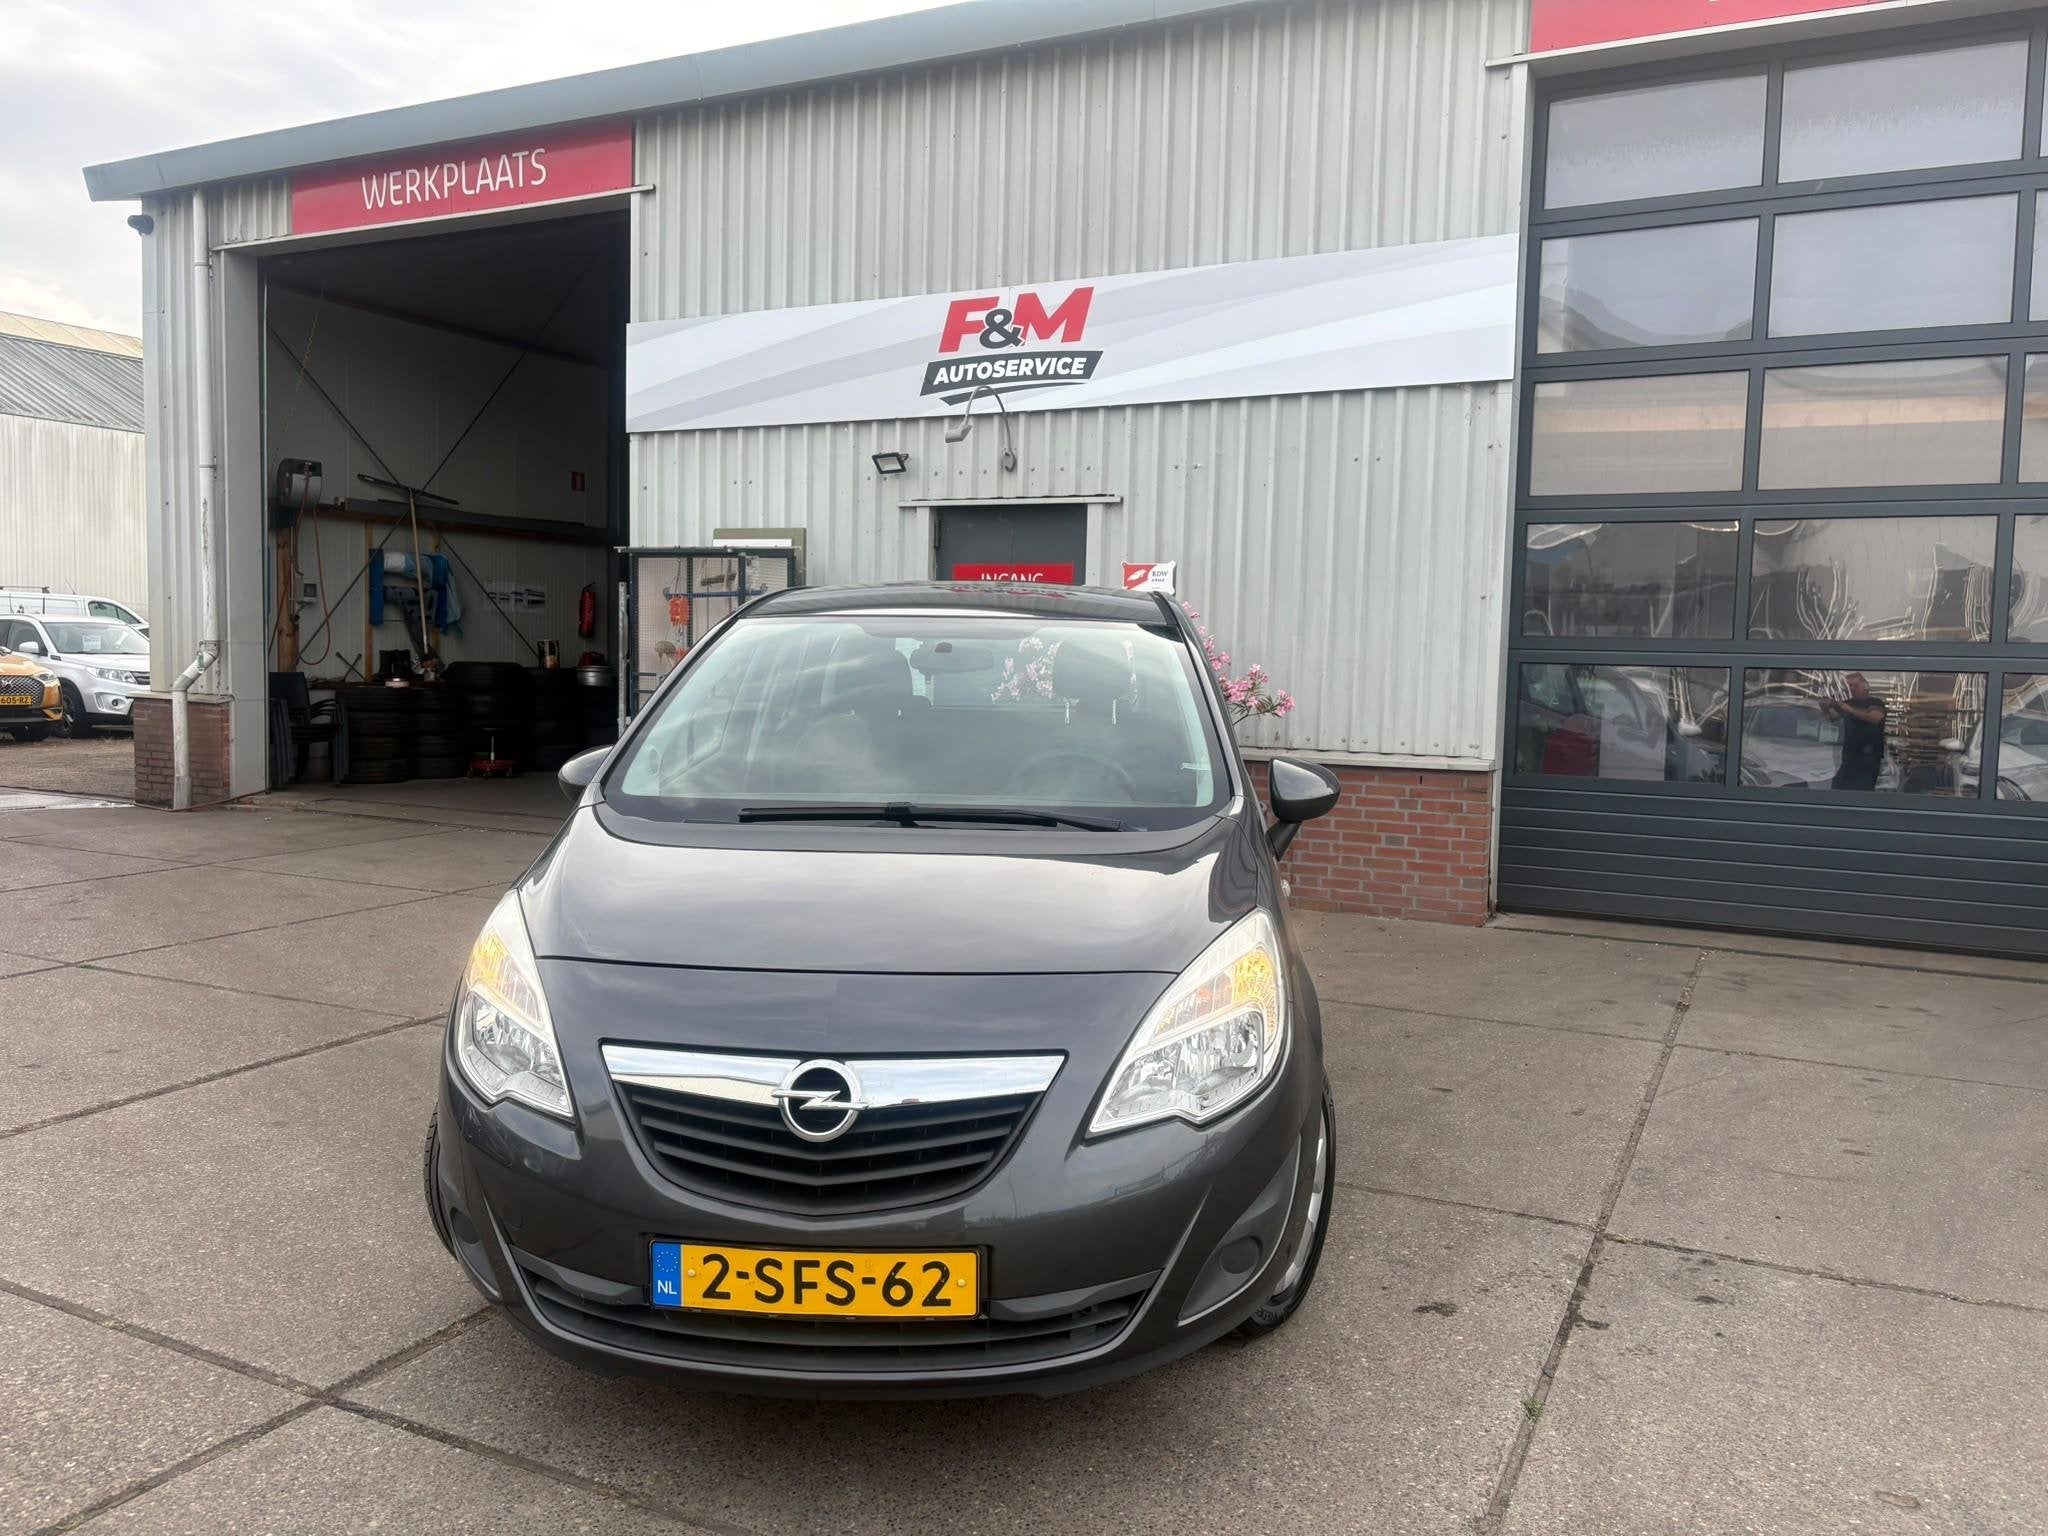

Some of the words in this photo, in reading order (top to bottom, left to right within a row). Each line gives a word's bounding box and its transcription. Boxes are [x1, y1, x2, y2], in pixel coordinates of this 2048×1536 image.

[361, 148, 547, 210] WERKPLAATS
[938, 286, 1095, 353] F&M
[933, 357, 1087, 385] AUTOSERVICE
[657, 1279, 677, 1294] NL
[702, 1253, 952, 1307] 2-SFS-62
